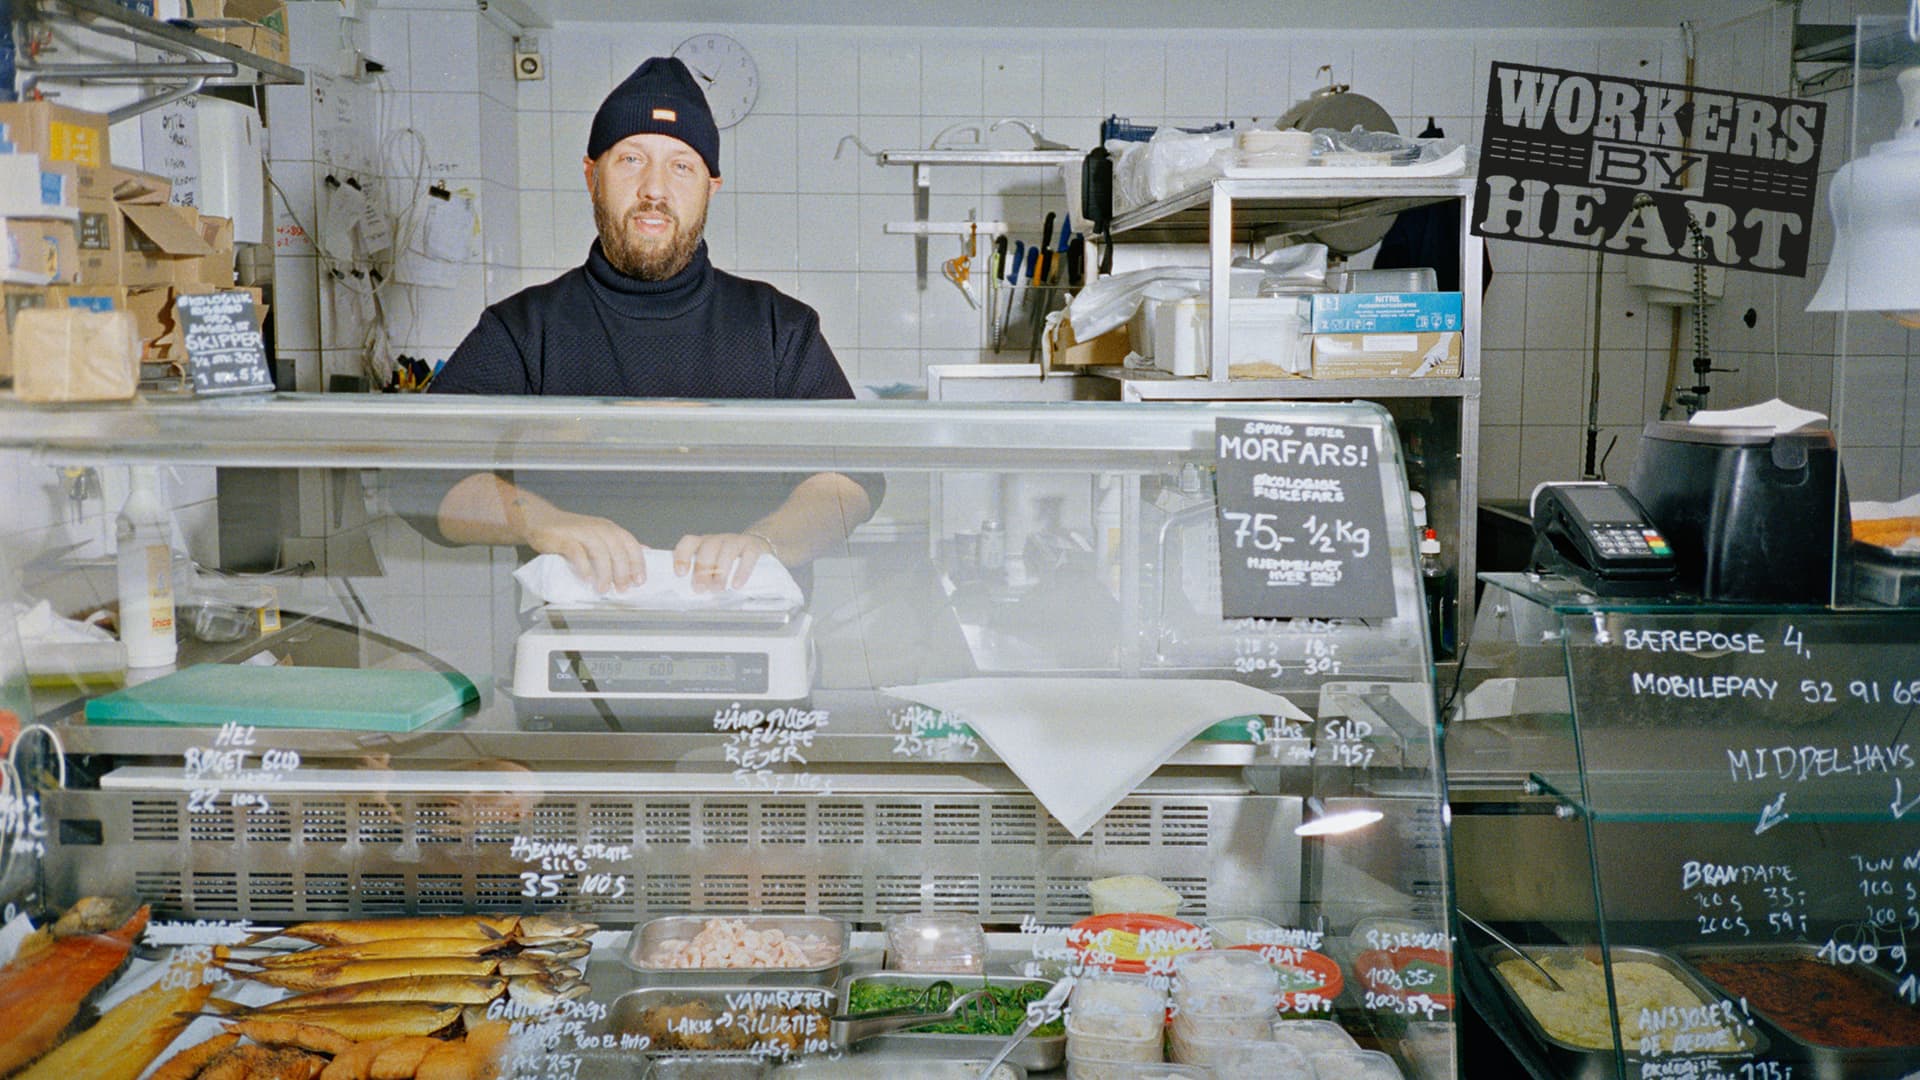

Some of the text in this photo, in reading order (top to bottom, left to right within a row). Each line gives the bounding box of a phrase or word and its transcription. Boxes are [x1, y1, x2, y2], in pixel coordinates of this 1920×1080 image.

[185, 332, 264, 350] SKIPPER
[1220, 435, 1368, 467] MORFARS!
[1223, 510, 1295, 551] 75,-
[1268, 570, 1306, 582] HVER
[1624, 629, 1766, 654] BÆREPOSE
[1632, 672, 1778, 700] MOBILEPAY
[1801, 680, 1837, 704] 52
[1849, 681, 1881, 704] 91
[215, 720, 257, 746] HEL
[722, 743, 808, 770] REJER
[1727, 744, 1915, 782] MIDDELHAVS
[1851, 854, 1894, 872] TUN
[520, 872, 565, 897] 35
[1817, 938, 1907, 974] 100 g
